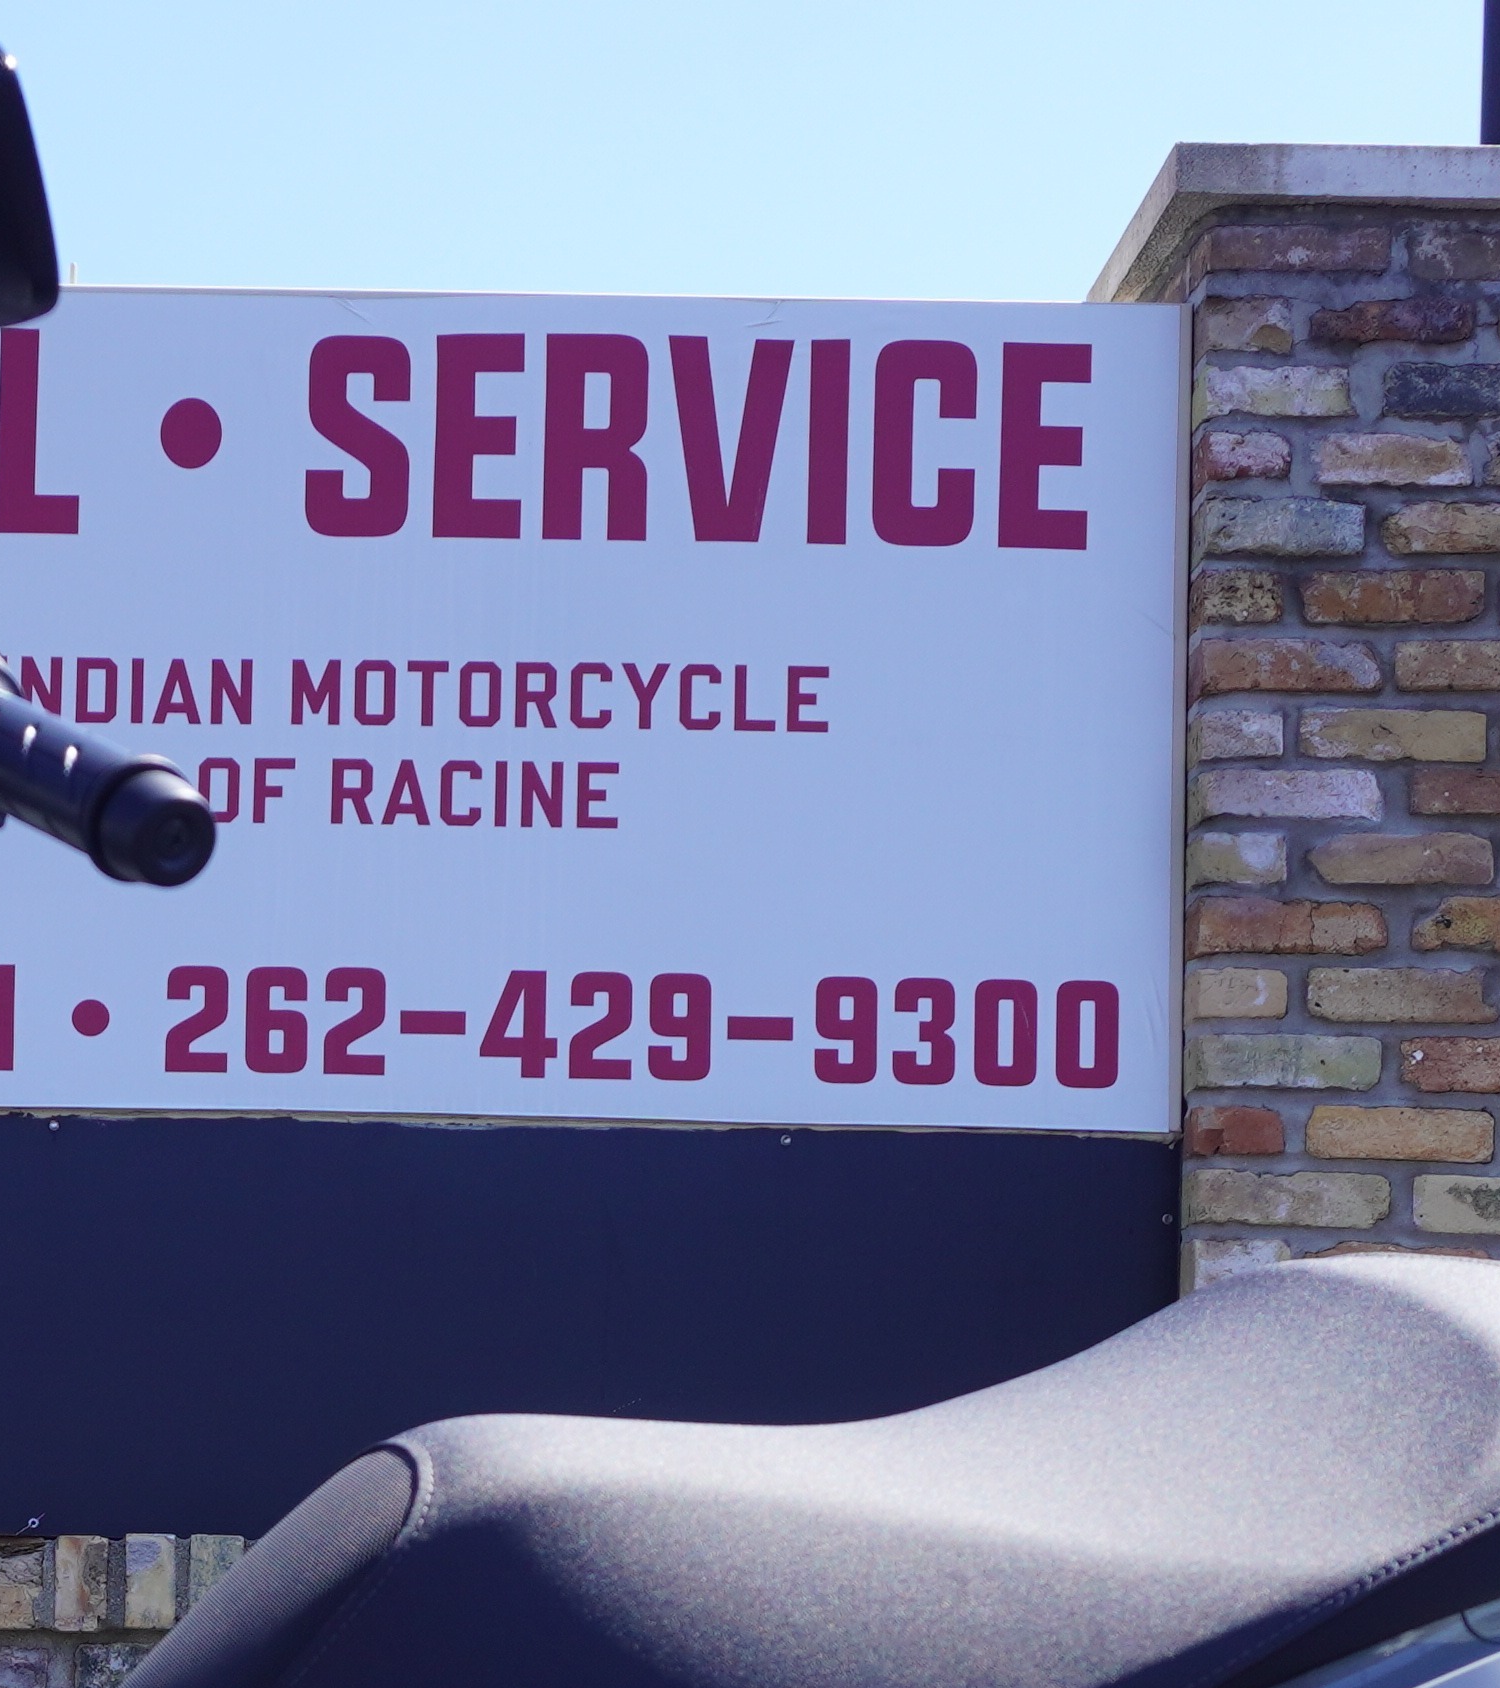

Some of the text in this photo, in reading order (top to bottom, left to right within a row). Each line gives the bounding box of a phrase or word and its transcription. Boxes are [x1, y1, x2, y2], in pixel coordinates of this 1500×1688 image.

[305, 333, 1093, 551] SERVICE
[2, 656, 829, 733] NDIAN MOTORCYCLE
[199, 757, 620, 830] OF RACINE
[165, 965, 1120, 1090] 262-429-9300
